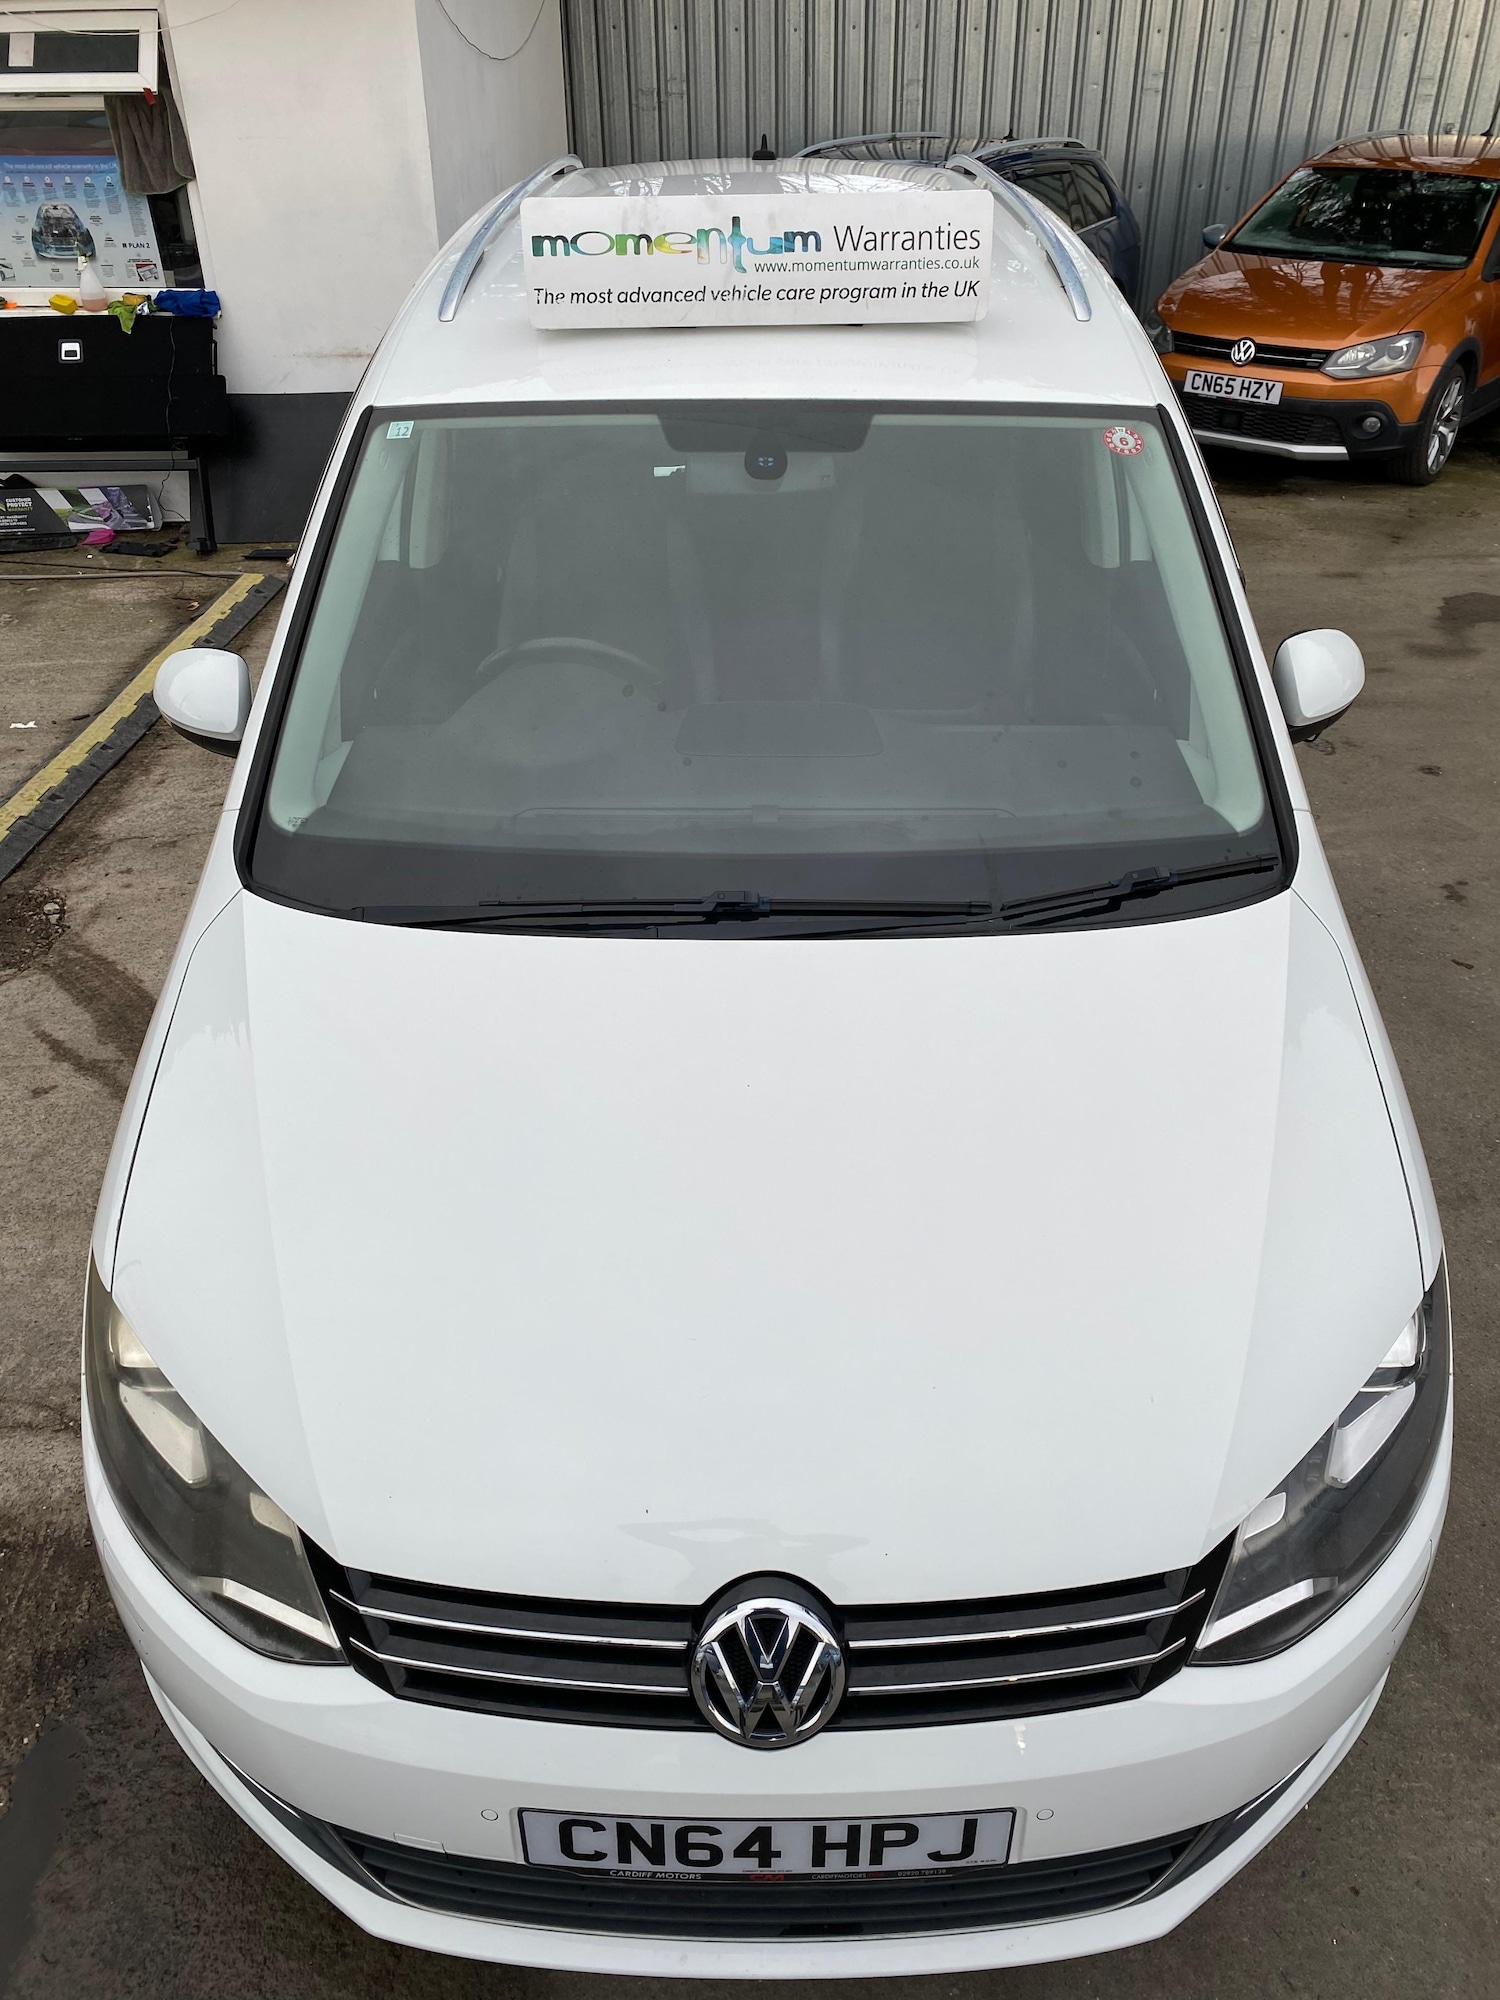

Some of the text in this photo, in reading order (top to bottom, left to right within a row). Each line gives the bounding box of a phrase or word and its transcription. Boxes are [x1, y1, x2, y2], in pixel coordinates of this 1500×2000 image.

[531, 216, 981, 273] momentum Warranties
[754, 256, 980, 273] www.momentumwarranties.co.uk
[534, 280, 980, 304] The most advanced vehicle care program in the UK
[1191, 373, 1276, 401] CN65 HZY
[395, 426, 409, 437] 12
[1119, 437, 1129, 446] 6
[558, 1818, 978, 1868] CN64 HPJ
[609, 1869, 653, 1879] CARDIFF
[655, 1872, 702, 1880] MOTORS
